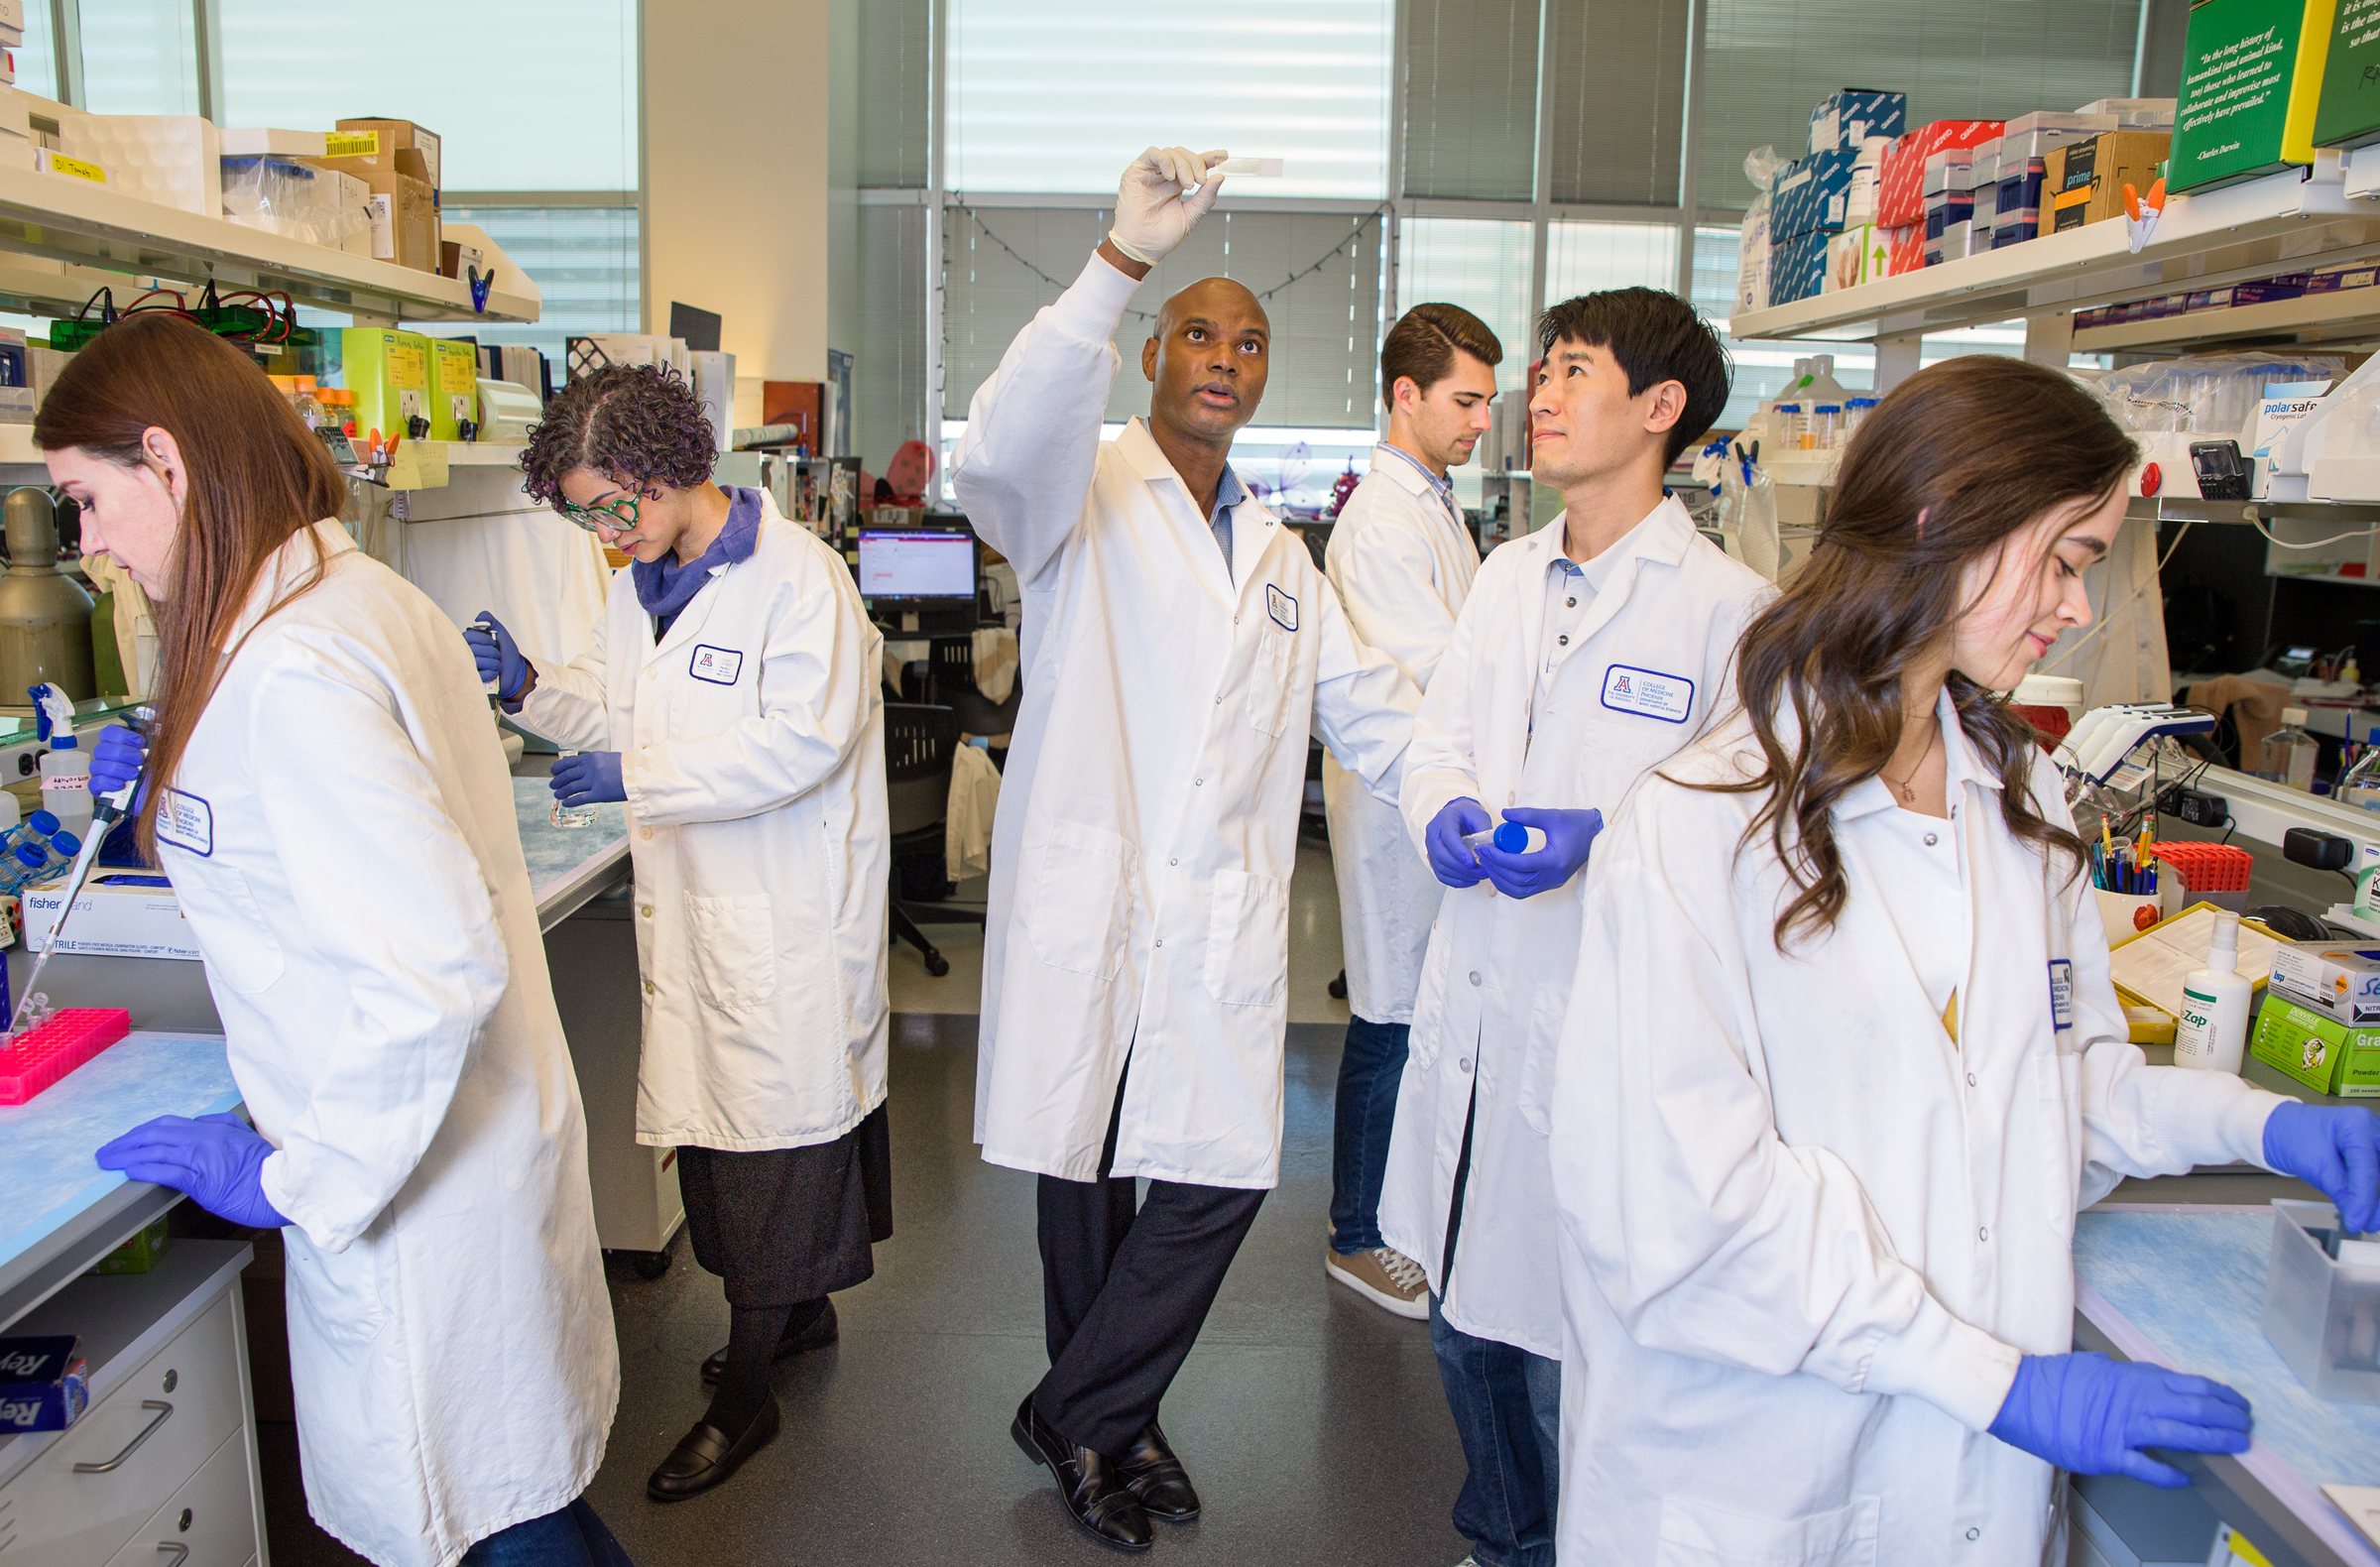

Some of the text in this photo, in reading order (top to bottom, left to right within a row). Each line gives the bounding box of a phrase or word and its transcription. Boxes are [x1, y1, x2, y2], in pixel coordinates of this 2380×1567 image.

[2340, 21, 2350, 34] is
[2350, 16, 2367, 31] the
[2211, 48, 2222, 60] the
[2223, 43, 2239, 56] long
[2239, 34, 2264, 52] history
[2264, 26, 2276, 41] of
[2348, 28, 2380, 49] so that
[2187, 64, 2222, 85] humankind
[2222, 58, 2239, 72] (and
[2238, 49, 2264, 64] animal
[2203, 78, 2221, 92] those
[2221, 73, 2237, 86] who
[2236, 64, 2264, 80] learned
[2263, 60, 2273, 70] to
[2181, 72, 2281, 116] collaborate and improvise most
[2183, 111, 2214, 132] effectively
[2213, 106, 2231, 119] have
[2220, 141, 2241, 155] Darwin
[2067, 171, 2091, 188] prime
[1642, 681, 1666, 690] COLLEGE
[1650, 688, 1674, 698] MEDICINE
[1640, 691, 1664, 701] PHOENIX
[29, 897, 92, 911] fisherand
[55, 940, 77, 950] TRILE
[2357, 1032, 2380, 1047] Gra
[0, 1397, 43, 1427] Re
